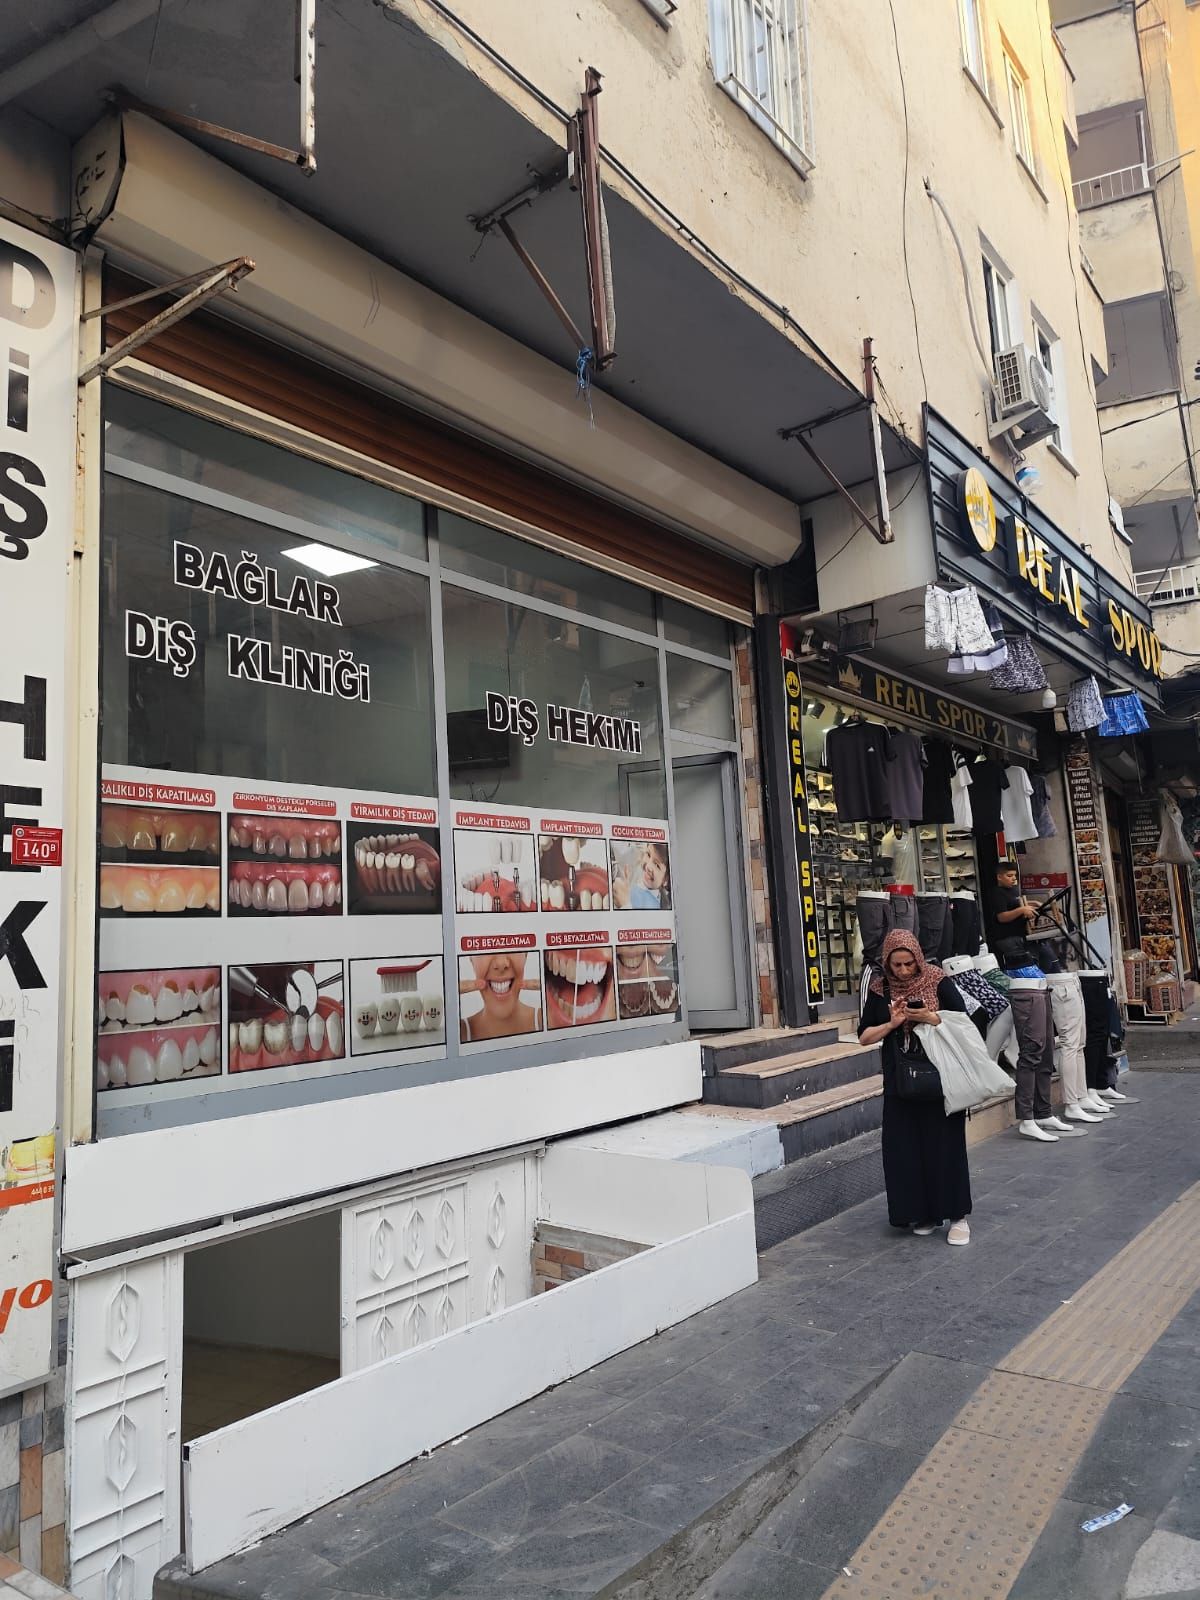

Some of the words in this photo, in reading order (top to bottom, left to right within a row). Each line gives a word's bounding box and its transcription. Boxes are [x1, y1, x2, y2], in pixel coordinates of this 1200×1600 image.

[174, 540, 342, 626] BAĞLAR
[1014, 515, 1090, 629] REAL
[1108, 598, 1164, 681] SPOR
[875, 673, 932, 721] REAL
[936, 700, 987, 740] SPOR
[992, 721, 1009, 747] 21
[138, 784, 154, 802] DİŞ
[156, 788, 213, 803] KAPATILMASI
[278, 805, 308, 813] KAPLAMA
[392, 807, 405, 821] DİŞ
[407, 810, 434, 821] TEDAVİ
[789, 703, 807, 834] REAL
[800, 860, 820, 995] SPOR
[466, 936, 480, 950] DİŞ
[482, 937, 531, 947] BEYAZLATMA
[551, 934, 562, 945] DİŞ
[563, 933, 605, 943] BEYAZLATMA
